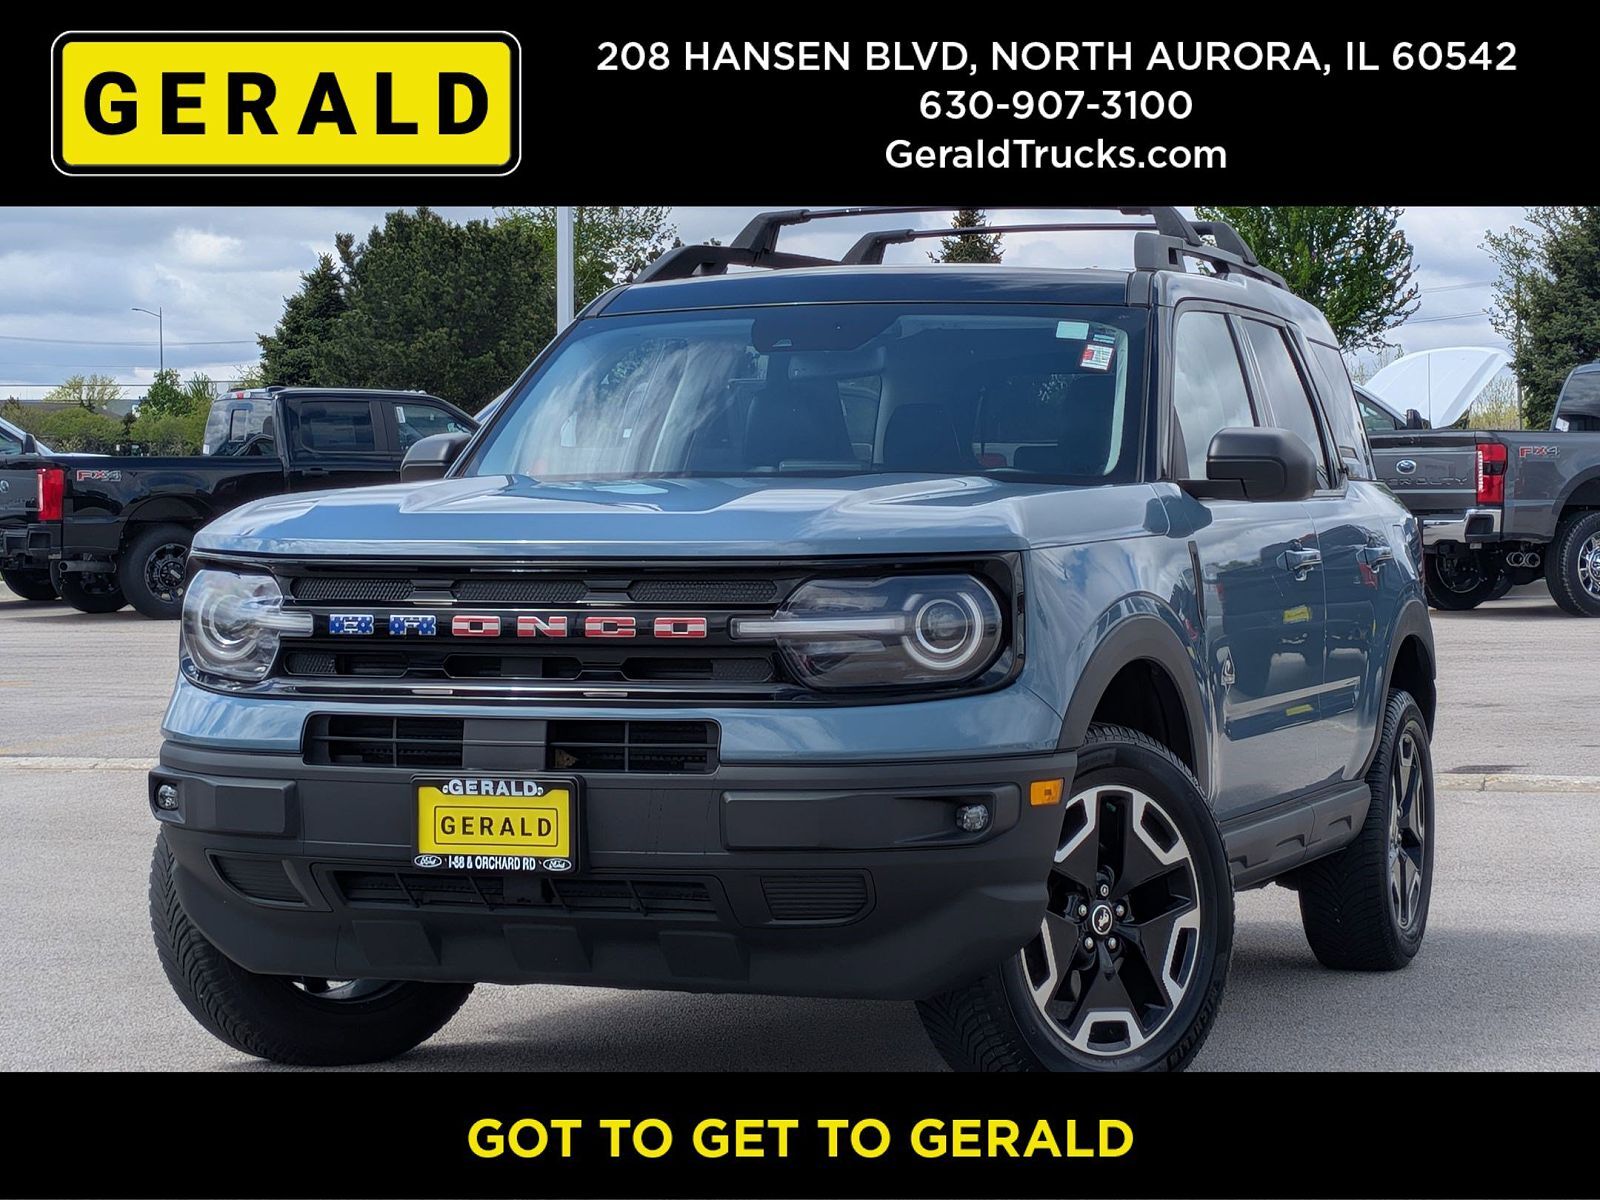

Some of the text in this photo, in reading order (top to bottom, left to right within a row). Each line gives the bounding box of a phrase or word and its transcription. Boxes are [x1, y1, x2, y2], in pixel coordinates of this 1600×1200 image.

[1519, 446, 1560, 458] FX4
[328, 613, 708, 639] BRONCO
[448, 778, 538, 797] GERALD
[440, 815, 552, 837] GERALD
[474, 855, 521, 870] ORCHARD
[522, 857, 536, 871] RD
